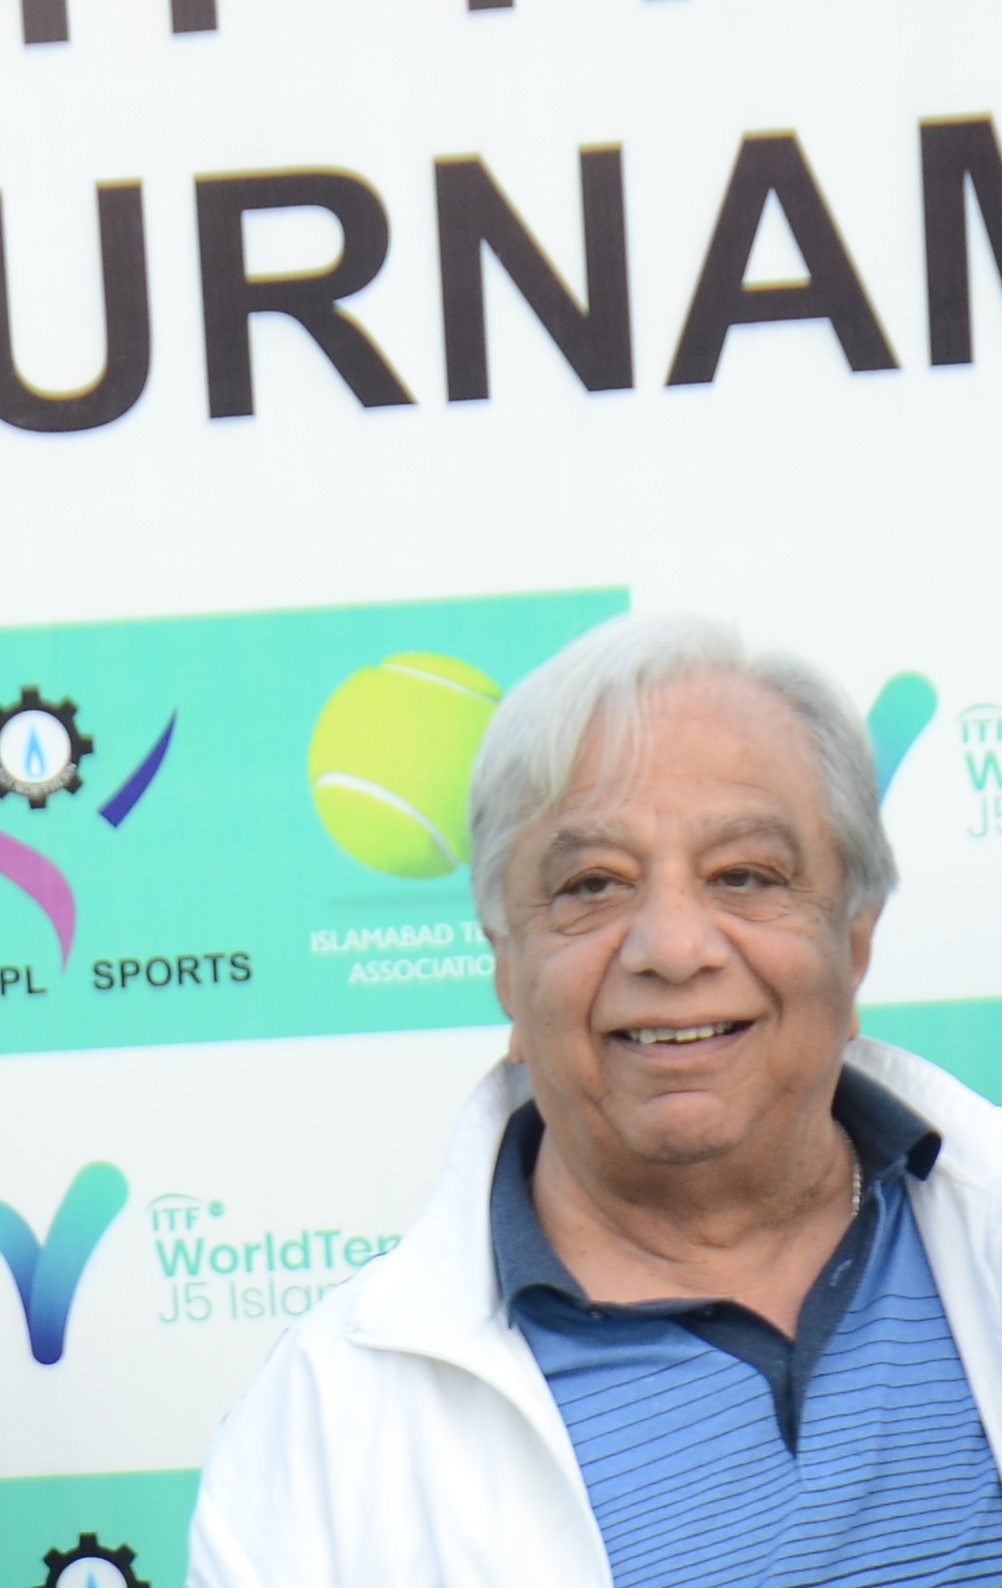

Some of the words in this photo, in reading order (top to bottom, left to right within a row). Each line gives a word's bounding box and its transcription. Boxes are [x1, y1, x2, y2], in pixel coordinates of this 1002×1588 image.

[310, 923, 455, 953] ISLAMABAD
[93, 951, 253, 991] SPORTS
[153, 1206, 200, 1232] ITF
[158, 1282, 213, 1324] J5
